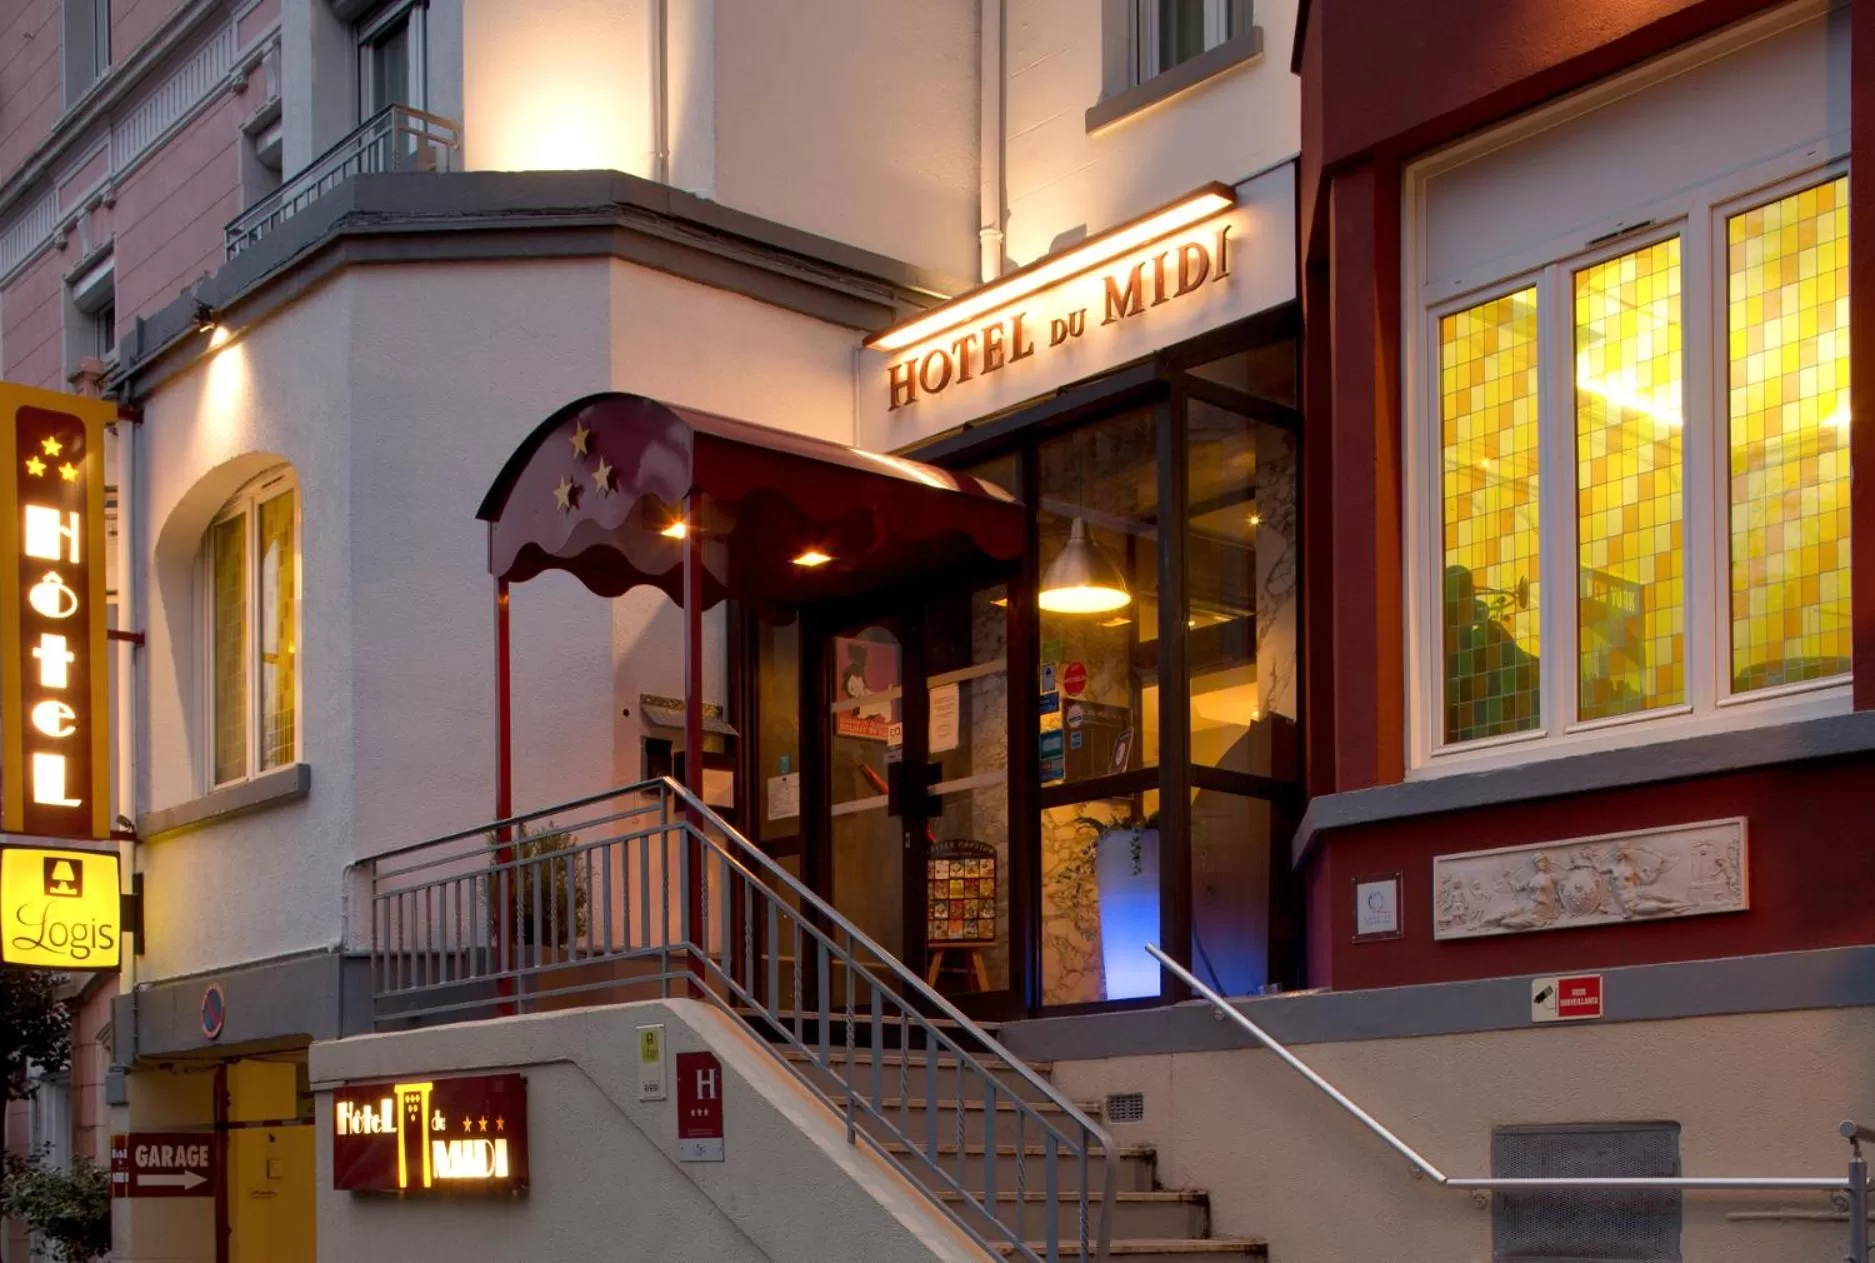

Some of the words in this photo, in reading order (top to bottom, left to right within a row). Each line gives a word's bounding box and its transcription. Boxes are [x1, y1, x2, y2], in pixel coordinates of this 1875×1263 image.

[887, 311, 1034, 412] HOTEL
[1049, 308, 1087, 348] DU
[1101, 224, 1232, 327] MIDI
[12, 900, 114, 960] Logis
[696, 1068, 716, 1100] H
[135, 1144, 209, 1168] GARAGE
[431, 1138, 509, 1179] MIDI
